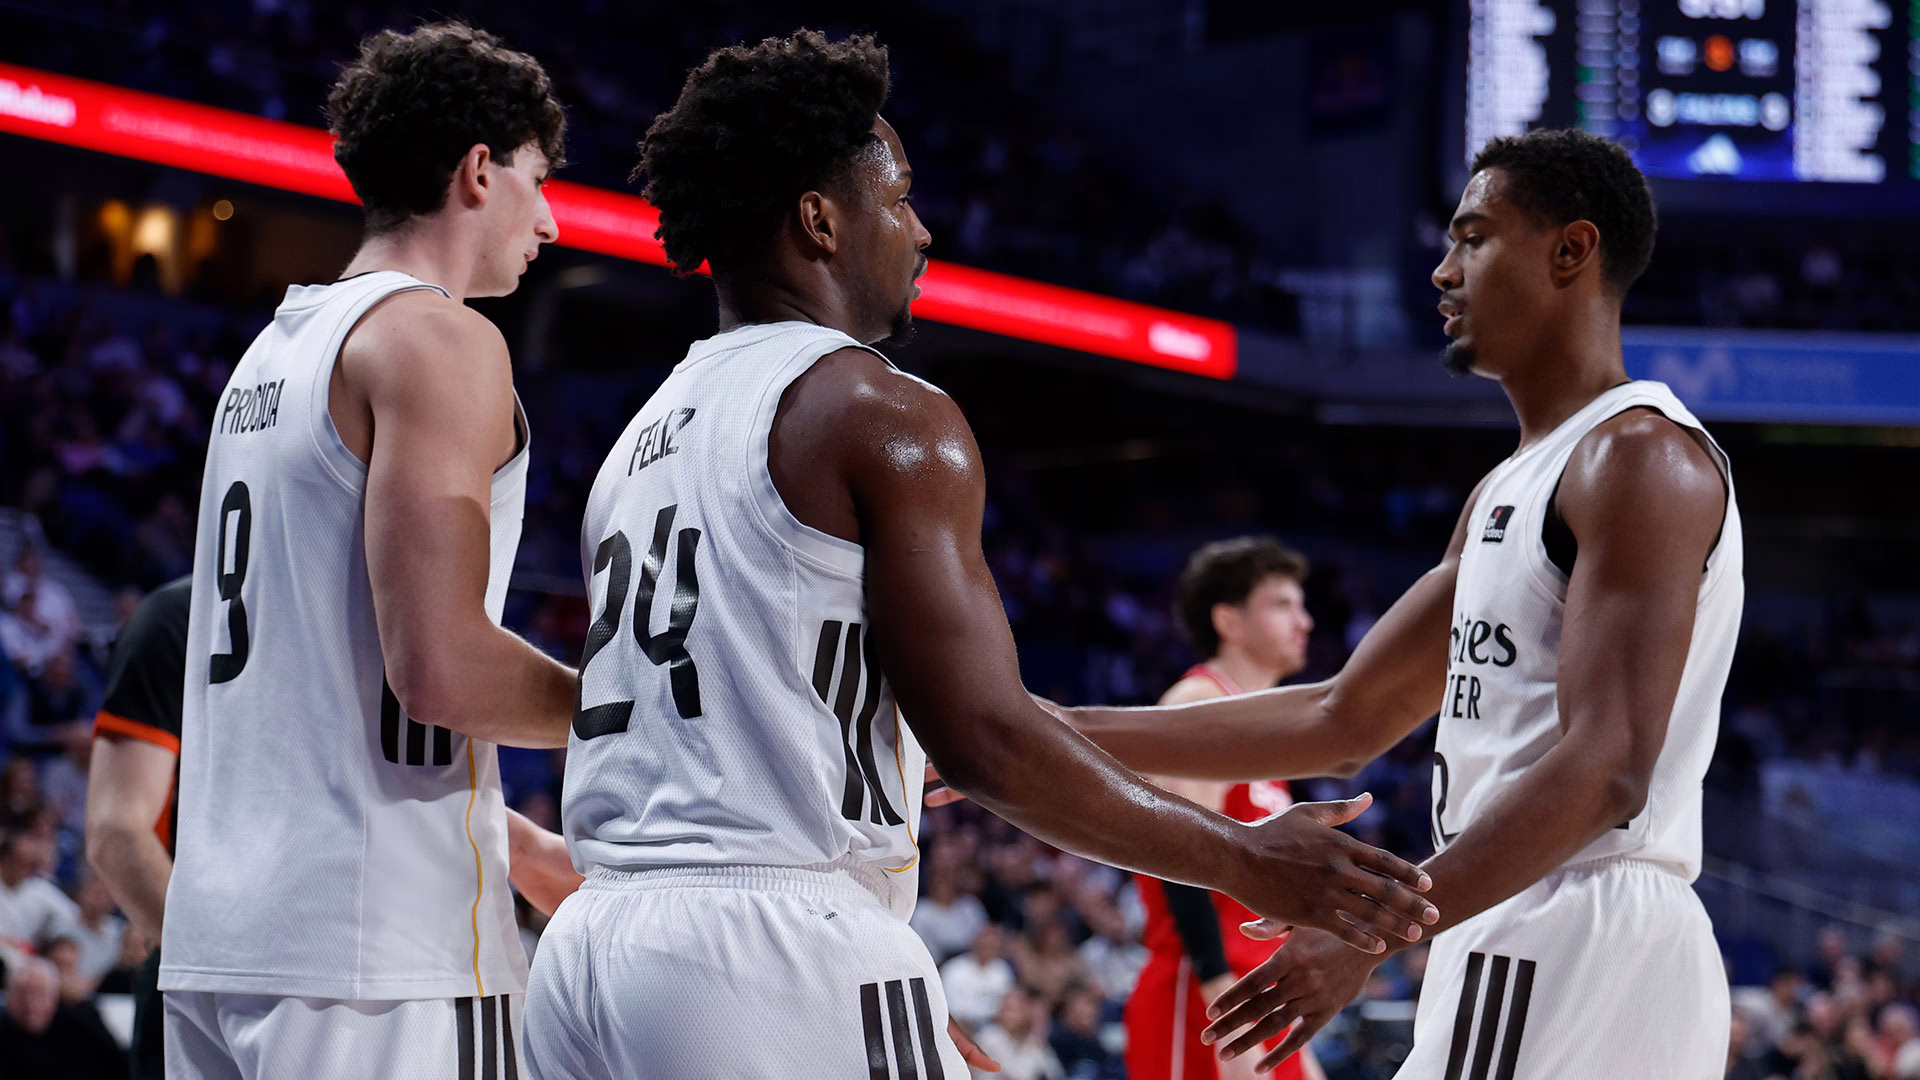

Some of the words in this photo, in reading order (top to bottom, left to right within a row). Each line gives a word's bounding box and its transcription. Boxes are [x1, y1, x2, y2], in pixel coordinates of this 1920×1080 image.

[219, 378, 286, 434] PROCIDA
[627, 407, 697, 477] FELIZ
[208, 481, 251, 685] 9
[572, 504, 703, 741] 24
[1443, 674, 1482, 720] TER
